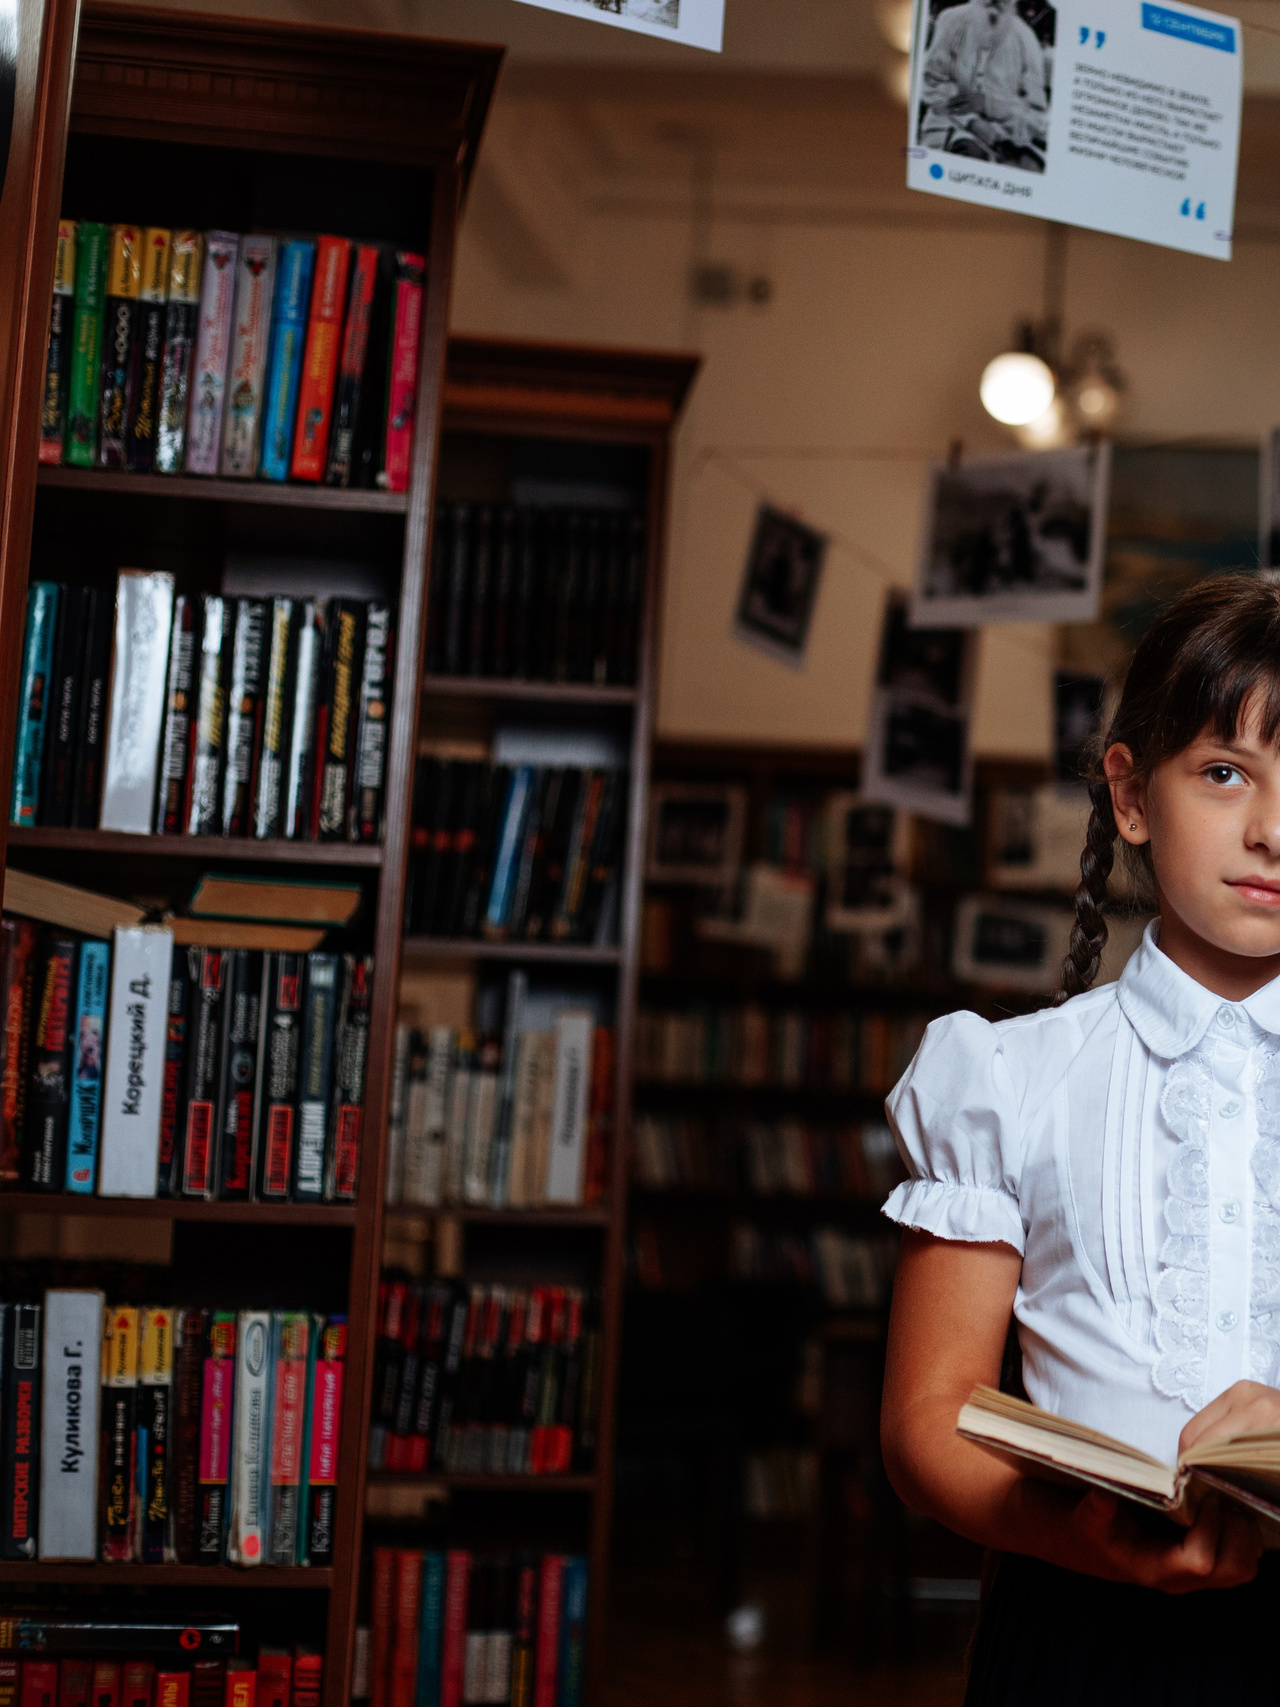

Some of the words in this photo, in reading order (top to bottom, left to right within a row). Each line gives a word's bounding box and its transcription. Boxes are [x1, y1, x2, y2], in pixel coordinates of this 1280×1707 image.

[132, 972, 152, 999] Д.
[123, 1002, 147, 1115] Корецкий
[64, 1340, 82, 1358] Г.
[15, 1380, 33, 1455] РАЗБОРКИ
[61, 1364, 84, 1473] Куликова
[12, 1461, 31, 1539] ПИТЕРСКИЕ
